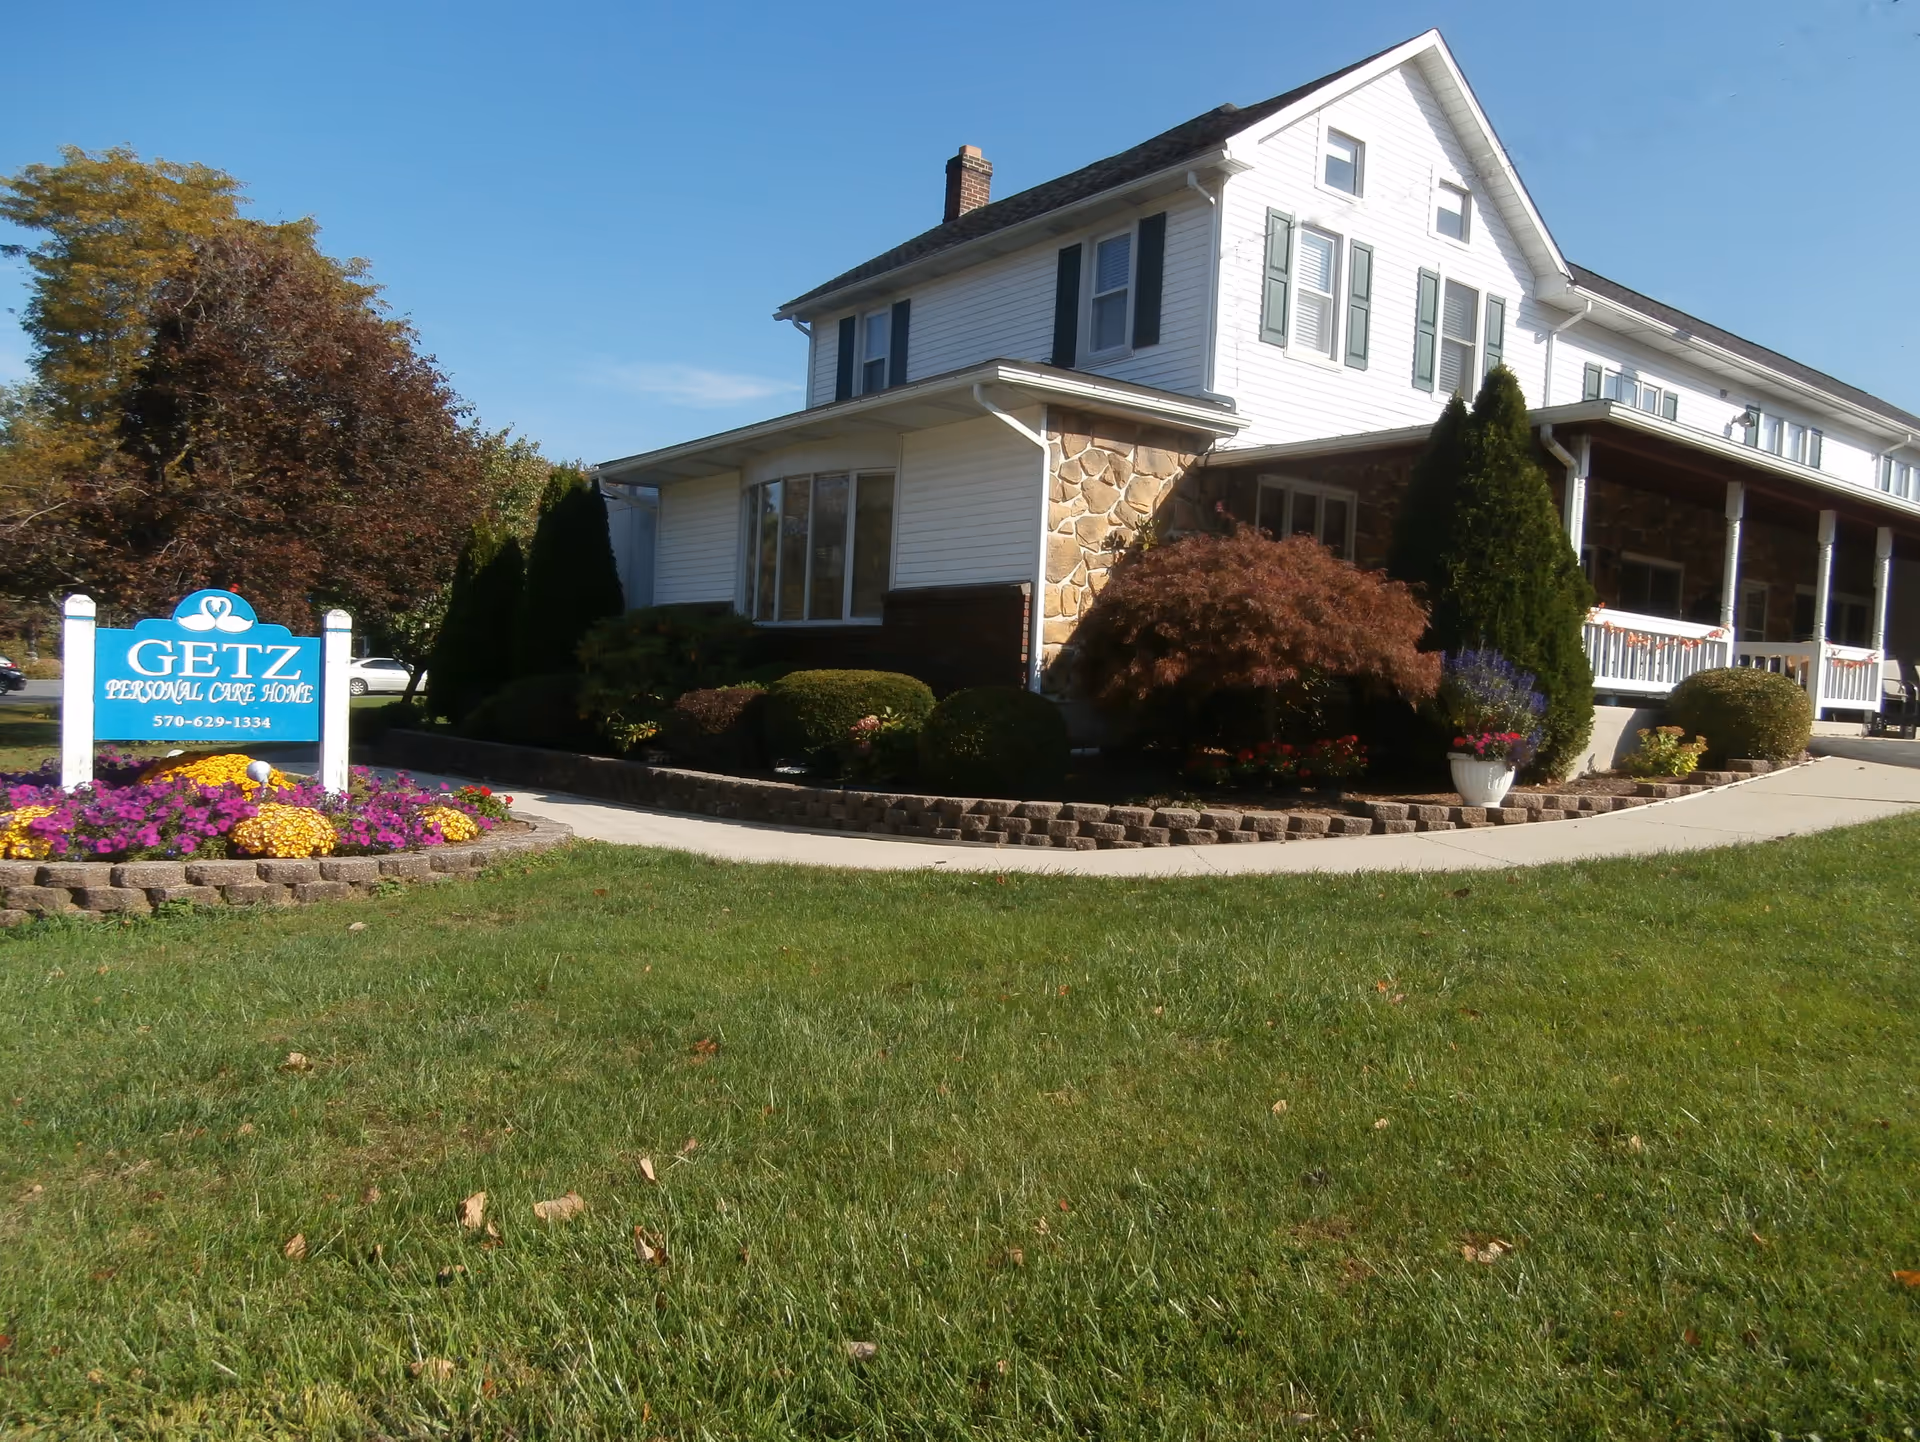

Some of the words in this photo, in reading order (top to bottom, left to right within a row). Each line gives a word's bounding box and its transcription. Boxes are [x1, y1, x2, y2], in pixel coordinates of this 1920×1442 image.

[127, 639, 301, 680] GETZ
[105, 679, 203, 704] PERSONAL
[209, 682, 256, 705] CARE
[260, 682, 314, 704] HOME
[153, 715, 271, 728] 570-629-1334
